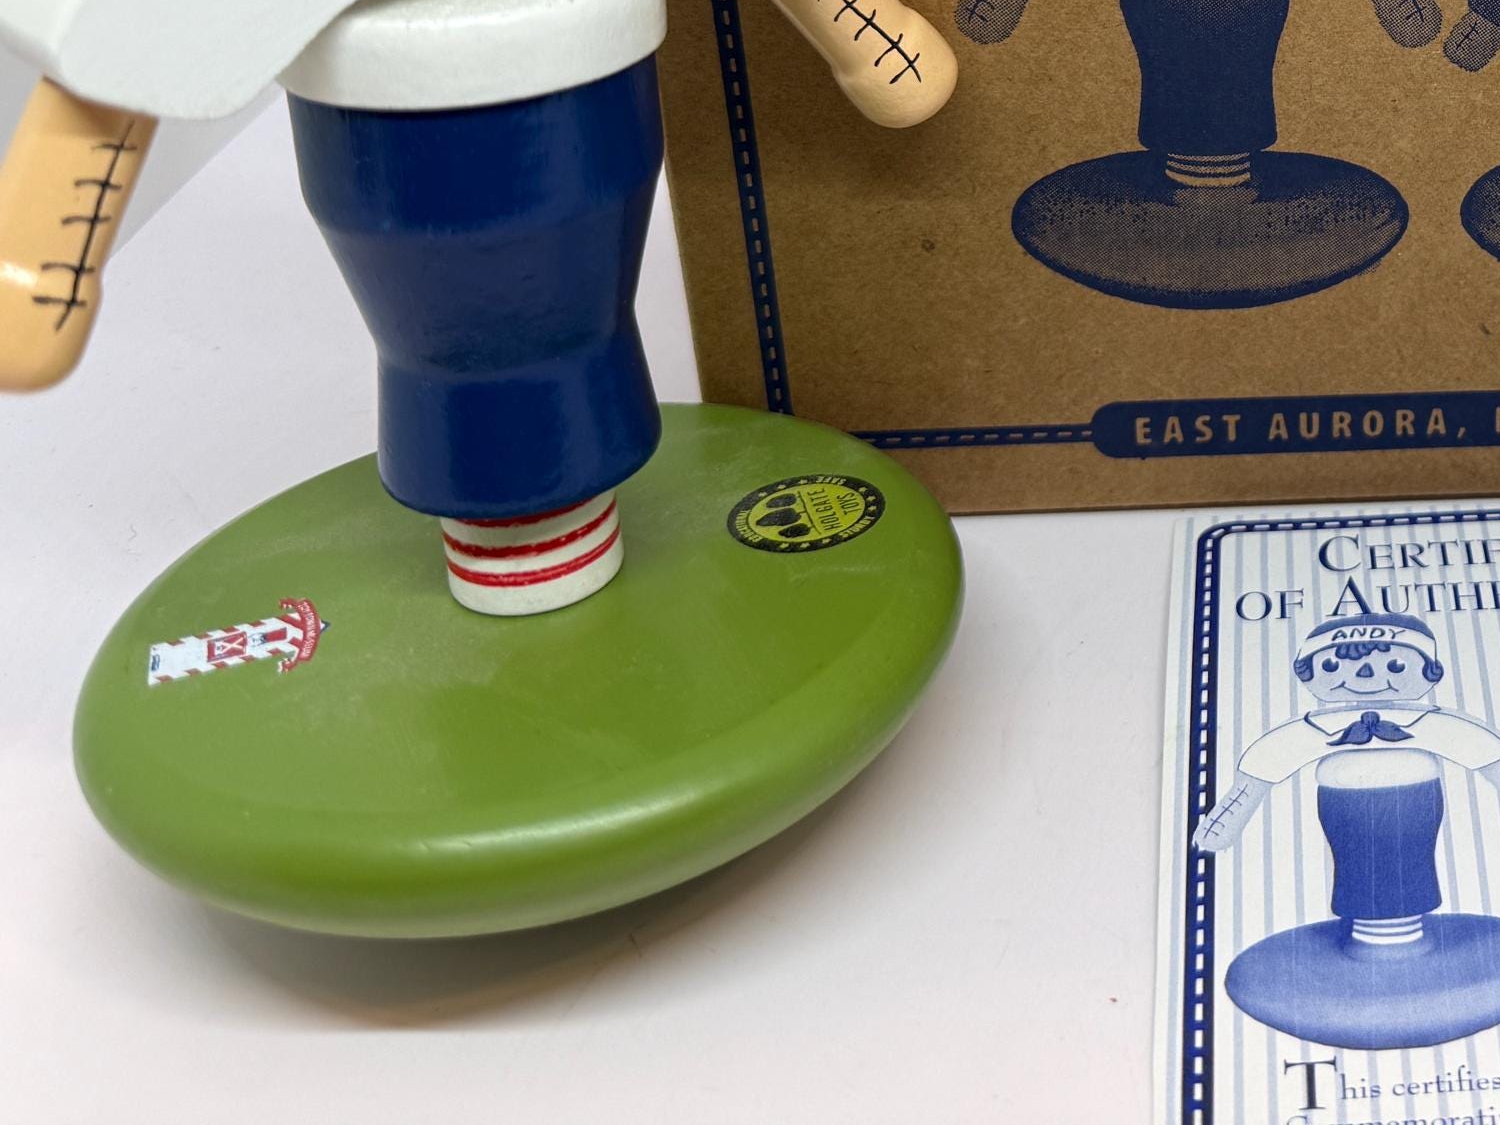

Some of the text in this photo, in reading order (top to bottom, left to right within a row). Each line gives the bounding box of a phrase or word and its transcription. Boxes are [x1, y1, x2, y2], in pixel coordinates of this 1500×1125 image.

[1135, 415, 1242, 445] EAST
[1268, 407, 1467, 441] AURORA,
[807, 488, 841, 531] HOLGATE
[837, 493, 862, 515] TOYS
[1236, 588, 1304, 621] OF
[1331, 627, 1406, 642] ANDY
[1284, 1055, 1382, 1111] This
